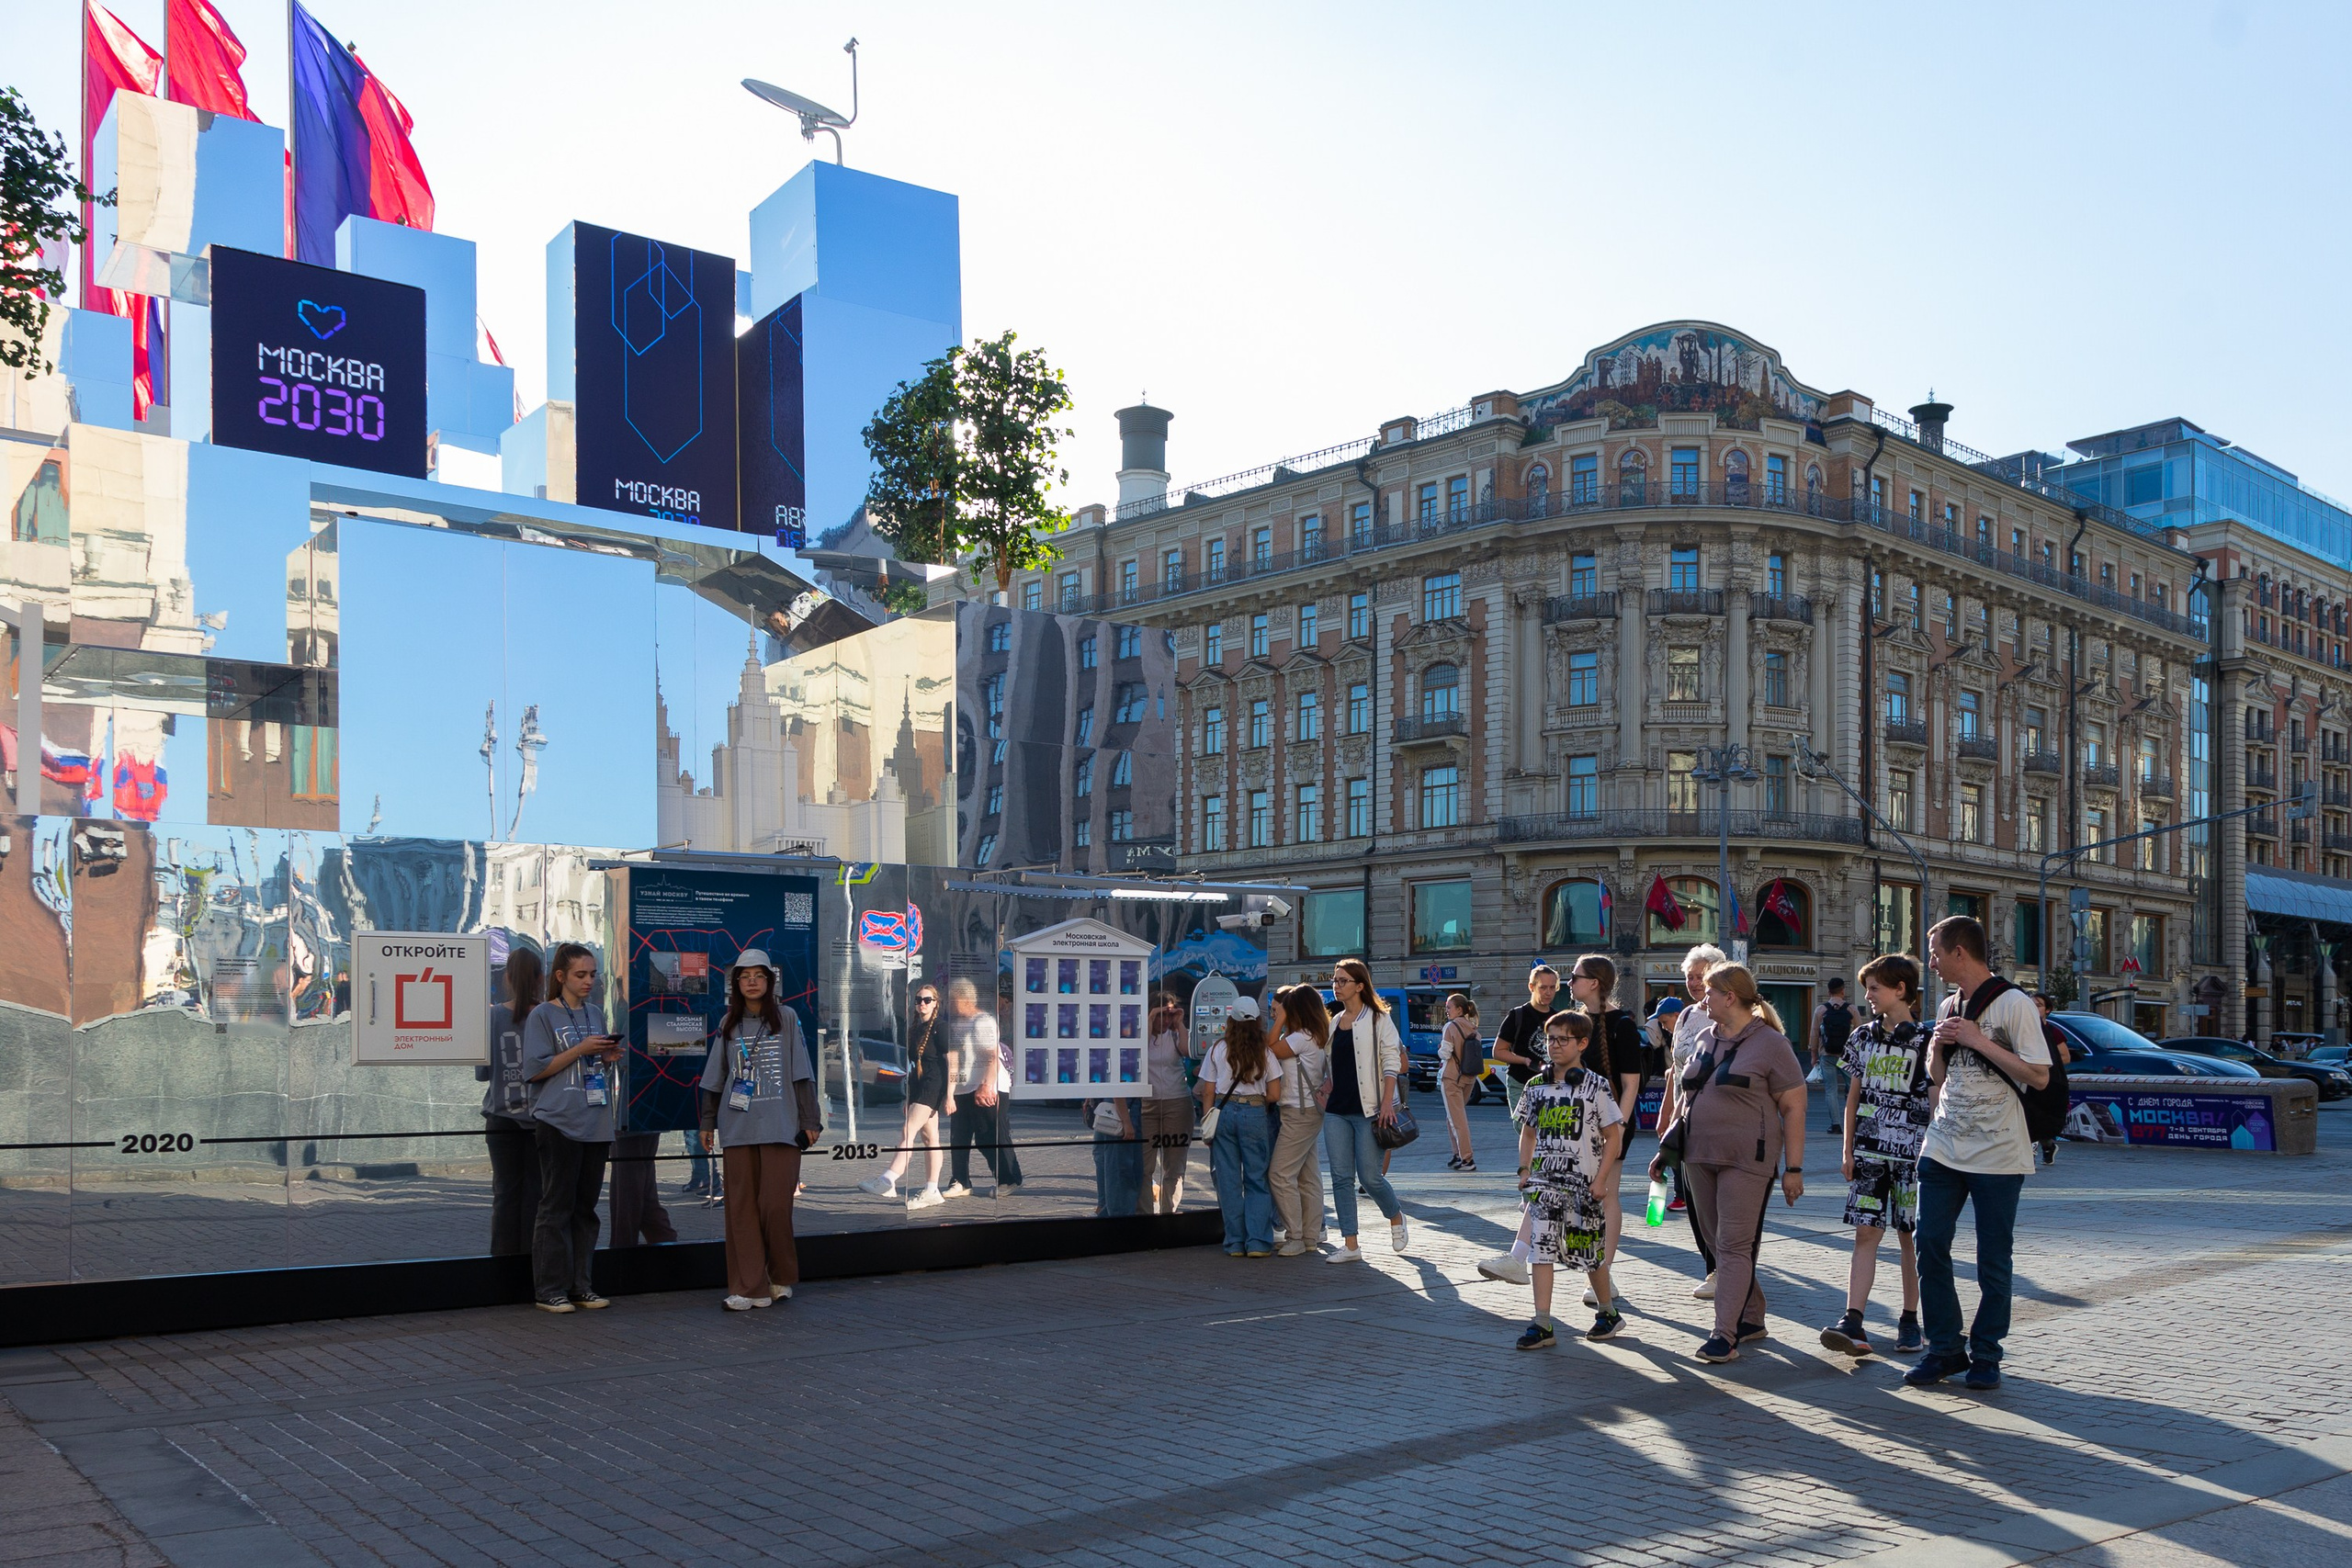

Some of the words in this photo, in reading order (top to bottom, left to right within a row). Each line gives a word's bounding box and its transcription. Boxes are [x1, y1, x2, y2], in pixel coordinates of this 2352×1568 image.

[258, 343, 384, 392] МОСКВА
[258, 377, 385, 441] 2030
[616, 478, 700, 513] МОСКВА
[1052, 939, 1097, 948] электронная
[1065, 932, 1107, 941] Московская
[380, 943, 467, 960] ОТКРОЙТЕ
[1758, 964, 1815, 976] НАЦИОНАЛЬ
[393, 1034, 453, 1043] ЭЛЕКТРОННЫЙ
[393, 1043, 414, 1051] ДОМ
[2128, 1097, 2133, 1106] С
[2138, 1097, 2160, 1107] ДНЕМ
[2129, 1109, 2225, 1126] МОСКВА!
[121, 1133, 194, 1155] 2020
[1151, 1133, 1190, 1150] 2012
[2193, 1134, 2228, 1142] ГОРОДА
[831, 1143, 879, 1161] 2013
